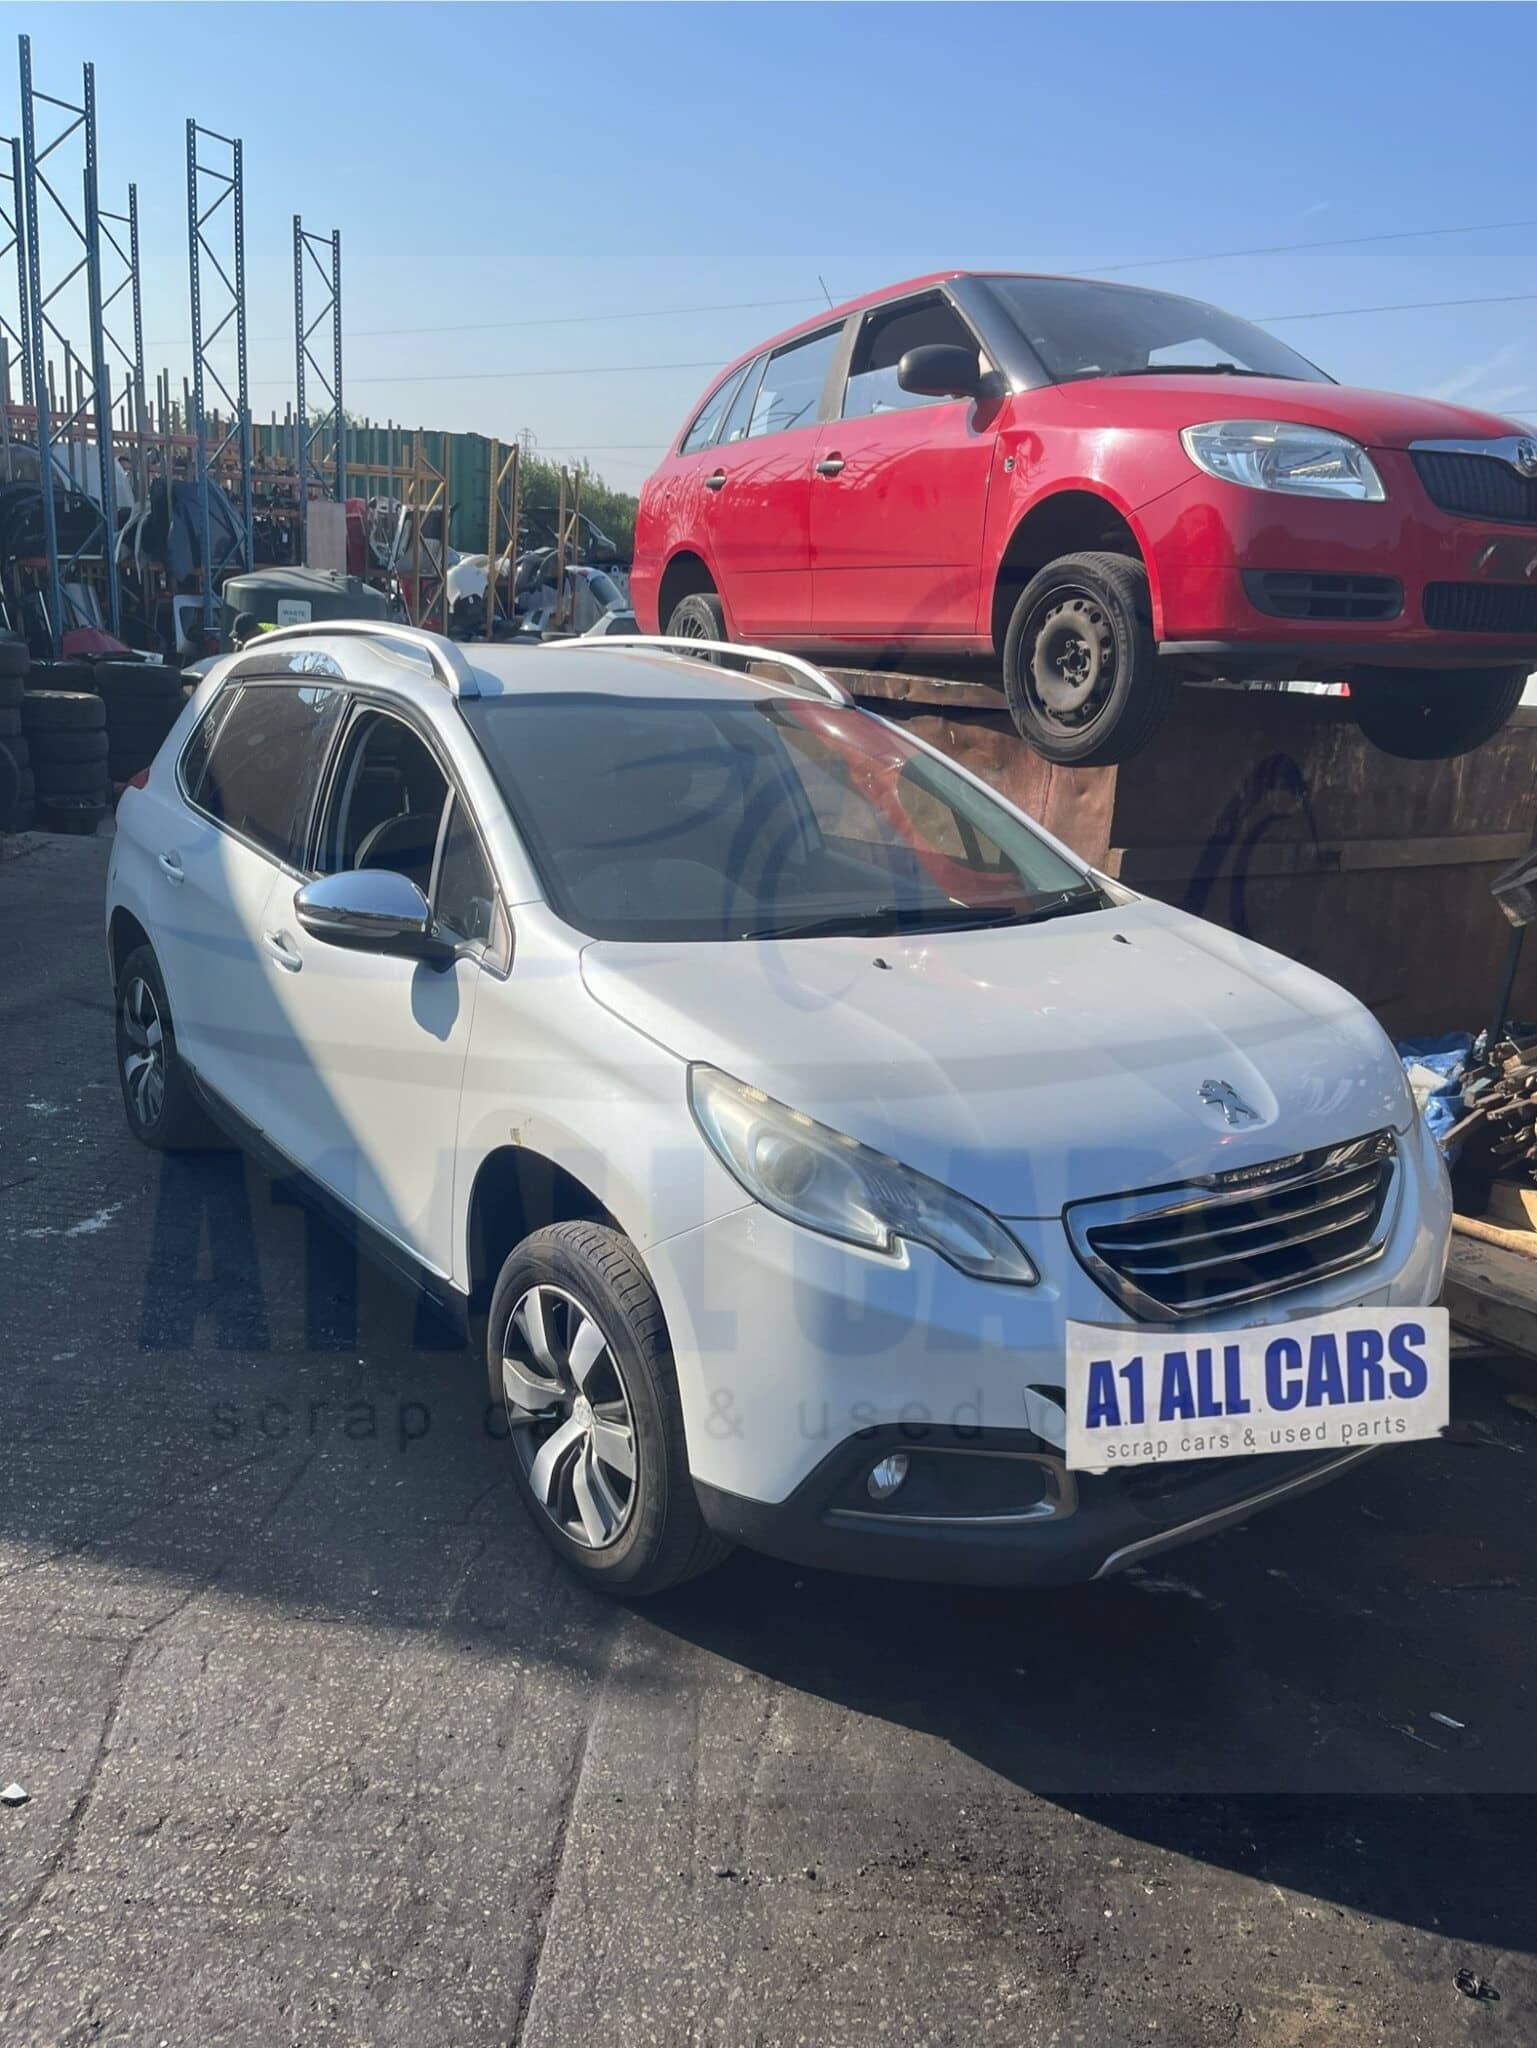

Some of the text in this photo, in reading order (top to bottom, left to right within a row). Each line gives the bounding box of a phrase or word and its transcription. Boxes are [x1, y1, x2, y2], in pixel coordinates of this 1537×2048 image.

[1085, 1357, 1145, 1429] A1
[1158, 1344, 1251, 1422] ALL
[1264, 1322, 1428, 1412] CARS
[1106, 1415, 1406, 1460] scrap cars & used parts
